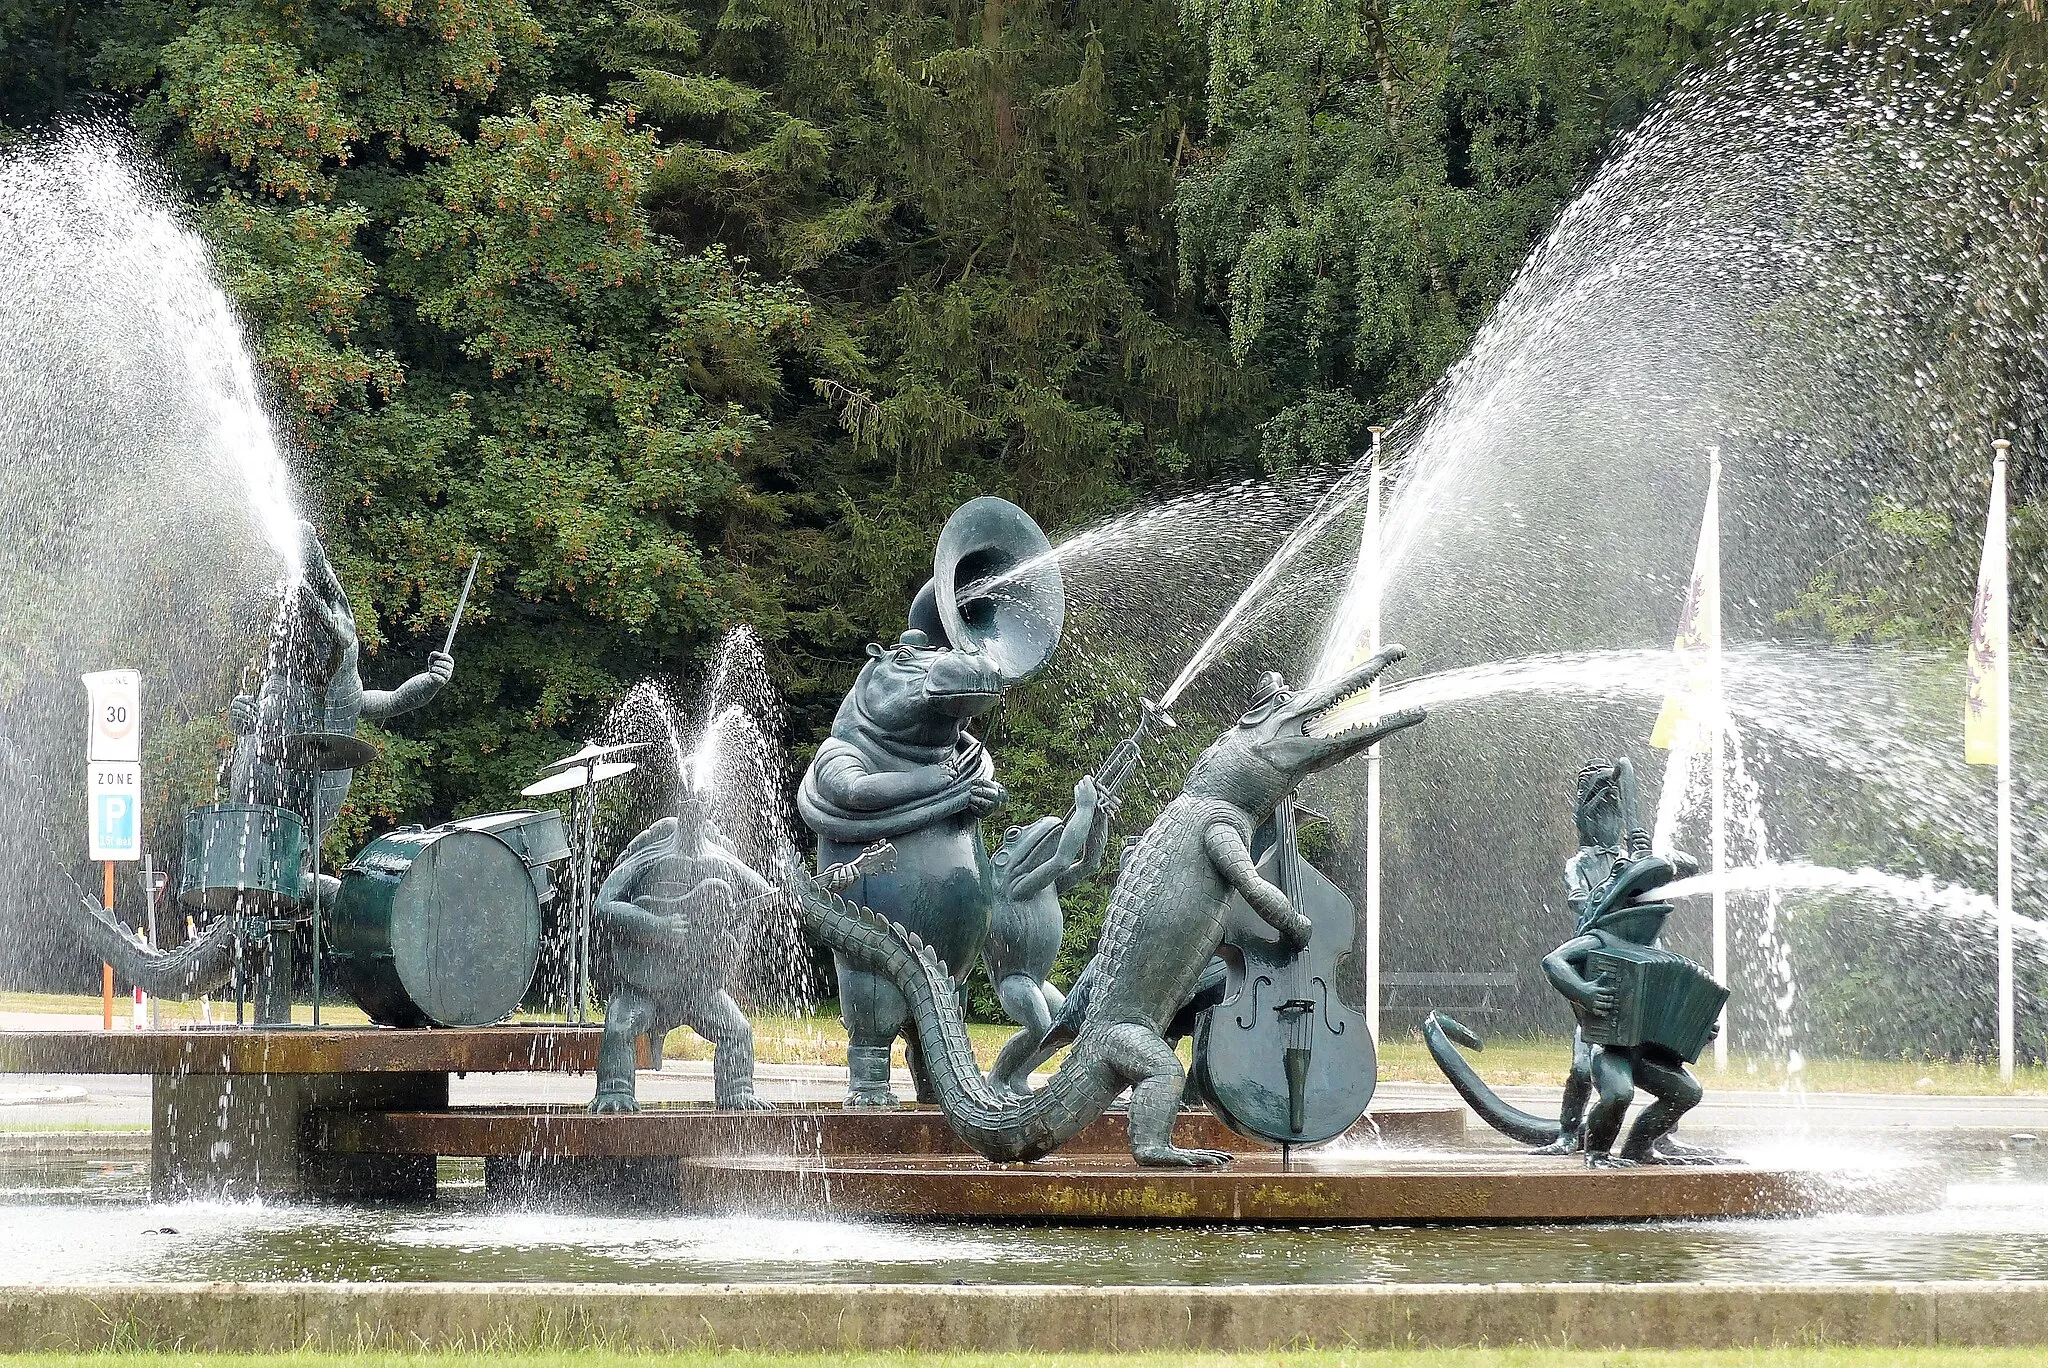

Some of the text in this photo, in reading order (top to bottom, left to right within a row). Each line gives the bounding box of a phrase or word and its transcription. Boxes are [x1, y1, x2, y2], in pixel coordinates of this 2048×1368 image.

[106, 706, 126, 723] 30
[98, 773, 133, 785] ZONE
[106, 798, 126, 833] P
